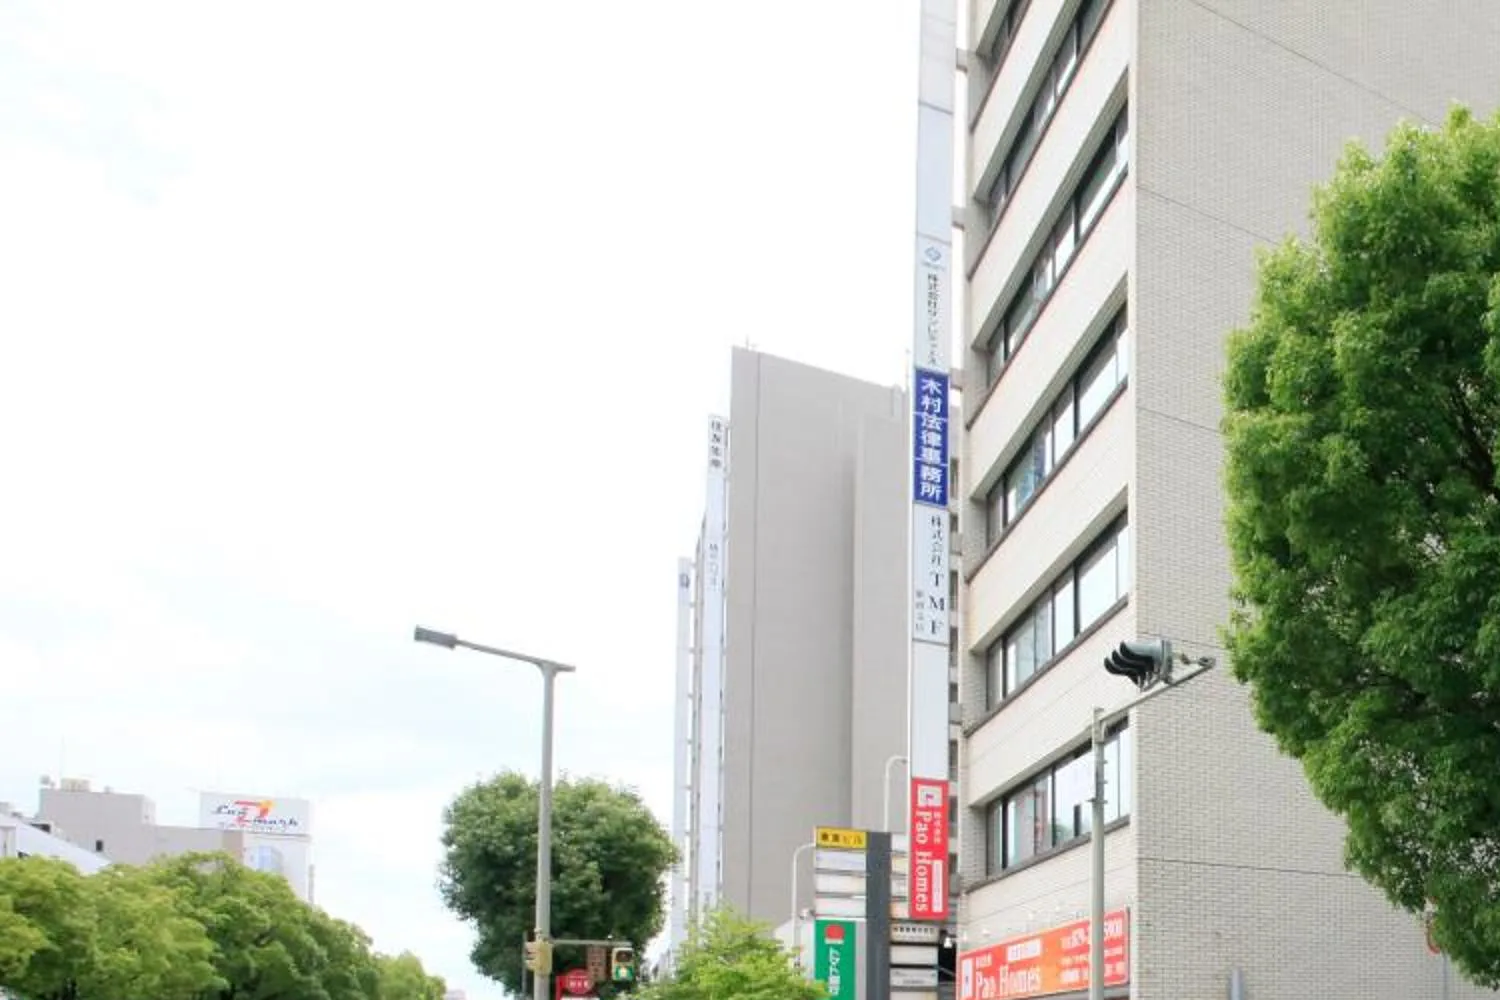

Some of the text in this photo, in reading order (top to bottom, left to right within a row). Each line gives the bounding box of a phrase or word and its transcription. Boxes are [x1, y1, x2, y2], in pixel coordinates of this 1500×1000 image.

[919, 378, 943, 501] 木村法律事務所
[915, 810, 933, 912] Pao Homes
[975, 970, 996, 1000] Pao
[999, 963, 1041, 997] Homes
